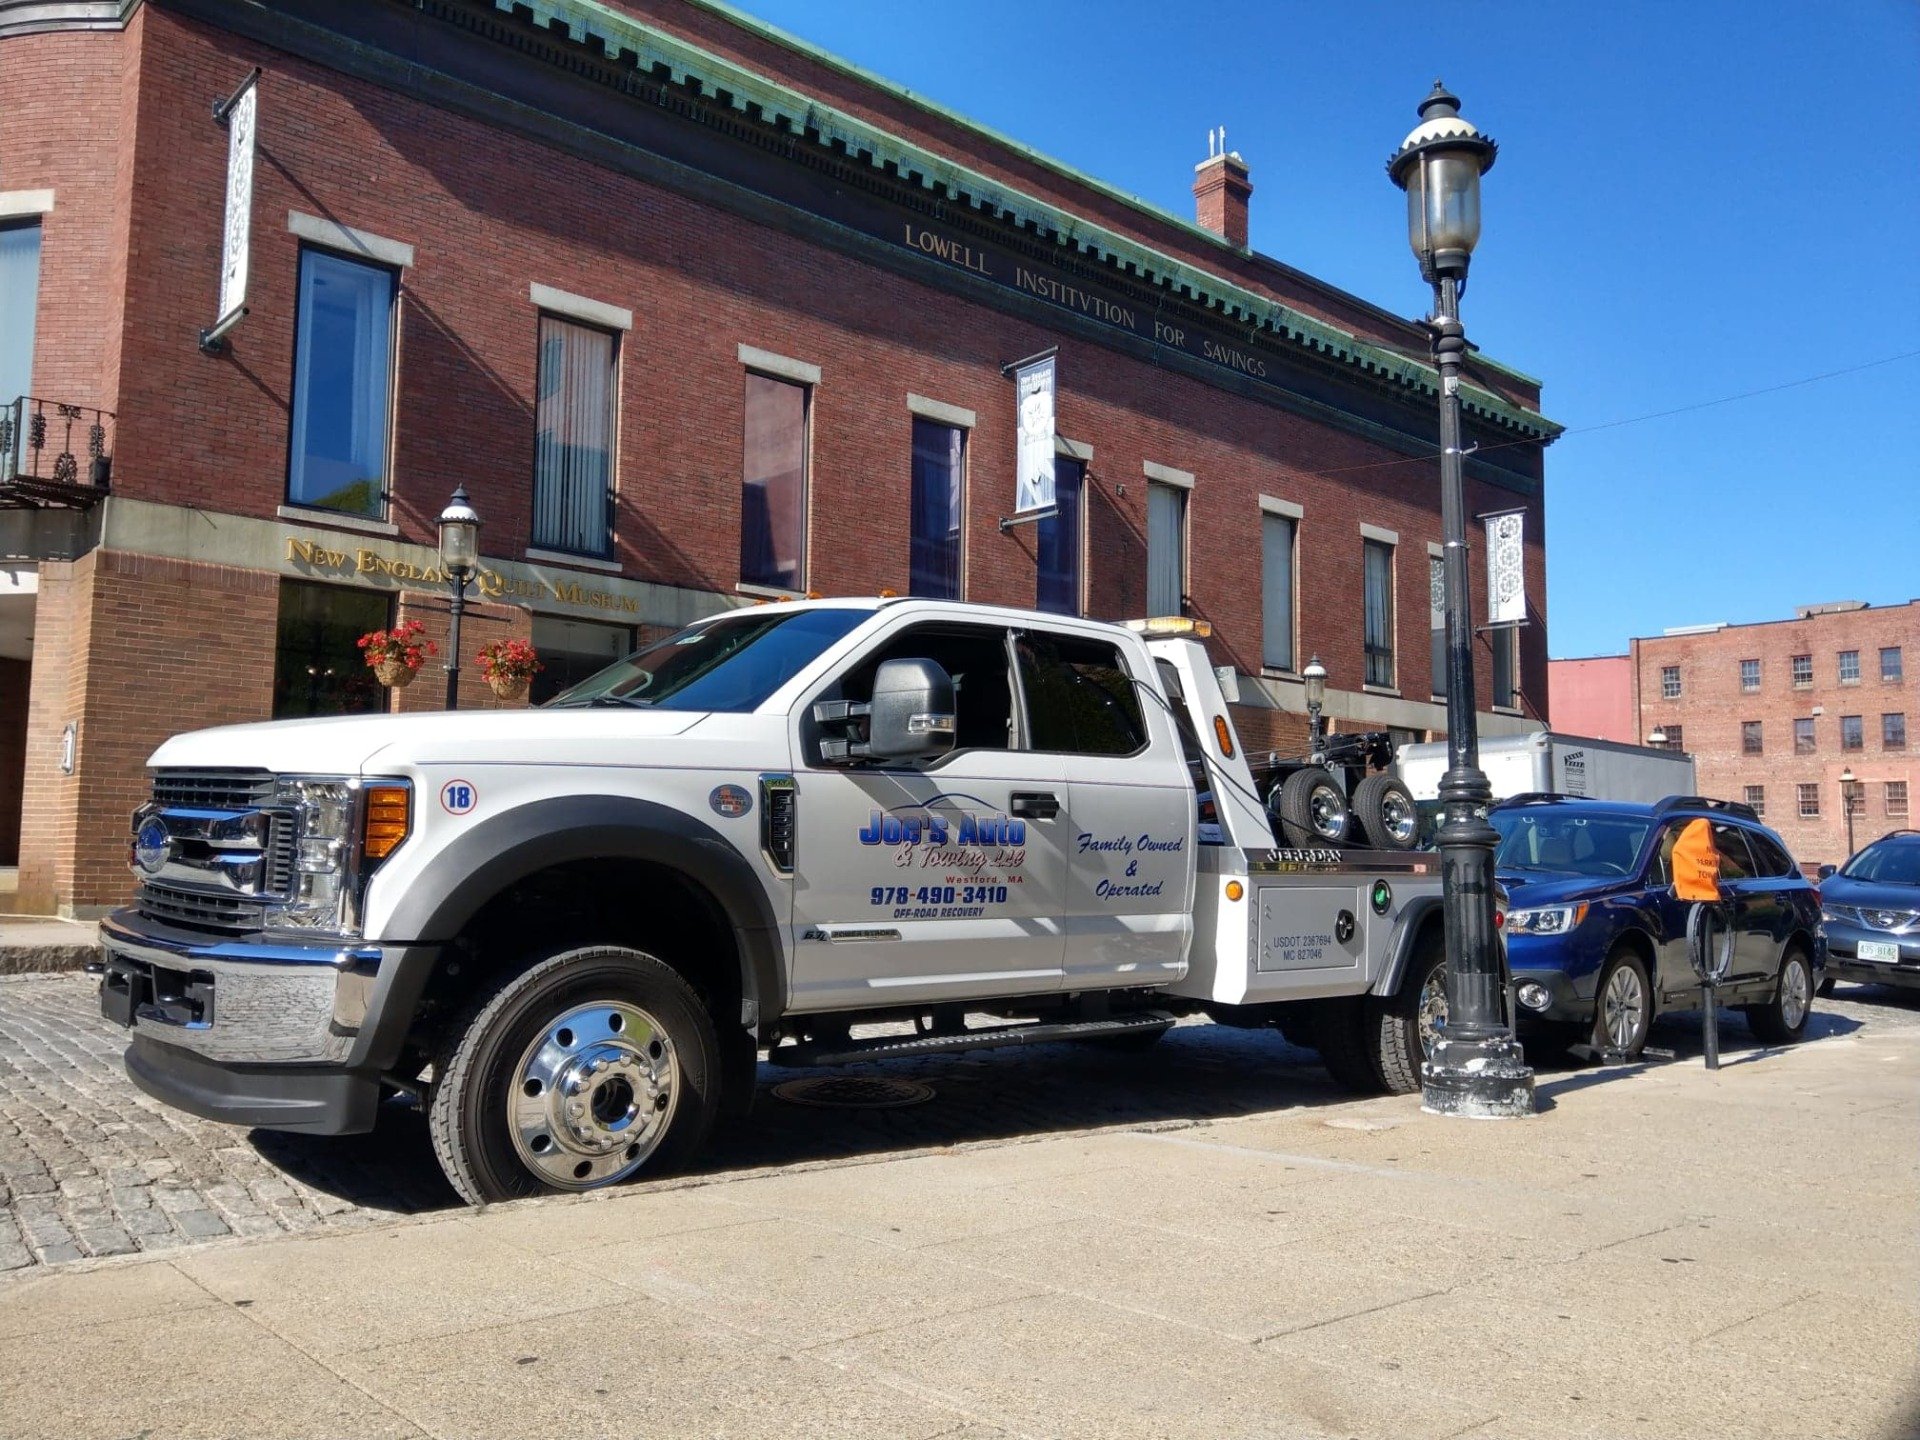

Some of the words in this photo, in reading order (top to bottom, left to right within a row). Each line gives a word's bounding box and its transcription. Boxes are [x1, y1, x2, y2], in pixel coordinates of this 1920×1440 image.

[905, 224, 992, 276] LOWELL
[1016, 267, 1136, 330] INSTITVTION
[1154, 320, 1186, 348] FOR
[1203, 340, 1267, 378] SAVINGS
[284, 536, 346, 569] NEW
[553, 576, 641, 614] MUSEUM
[447, 786, 470, 809] 18
[858, 809, 950, 846] Joe's
[957, 811, 1027, 847] Auto
[1077, 832, 1133, 856] Family
[1136, 833, 1184, 852] Owned
[893, 840, 913, 868] &
[919, 842, 988, 875] Towing
[989, 848, 1027, 869] LLC
[1125, 859, 1138, 877] &
[945, 875, 1002, 884] Westford,
[1007, 875, 1024, 884] MA
[1095, 879, 1164, 902] Operated
[870, 885, 1008, 906] 978-490-3410
[893, 907, 938, 919] OFF-ROAD
[940, 905, 985, 918] RECOVERY
[1273, 936, 1300, 948] USDOT
[1283, 950, 1296, 961] MC
